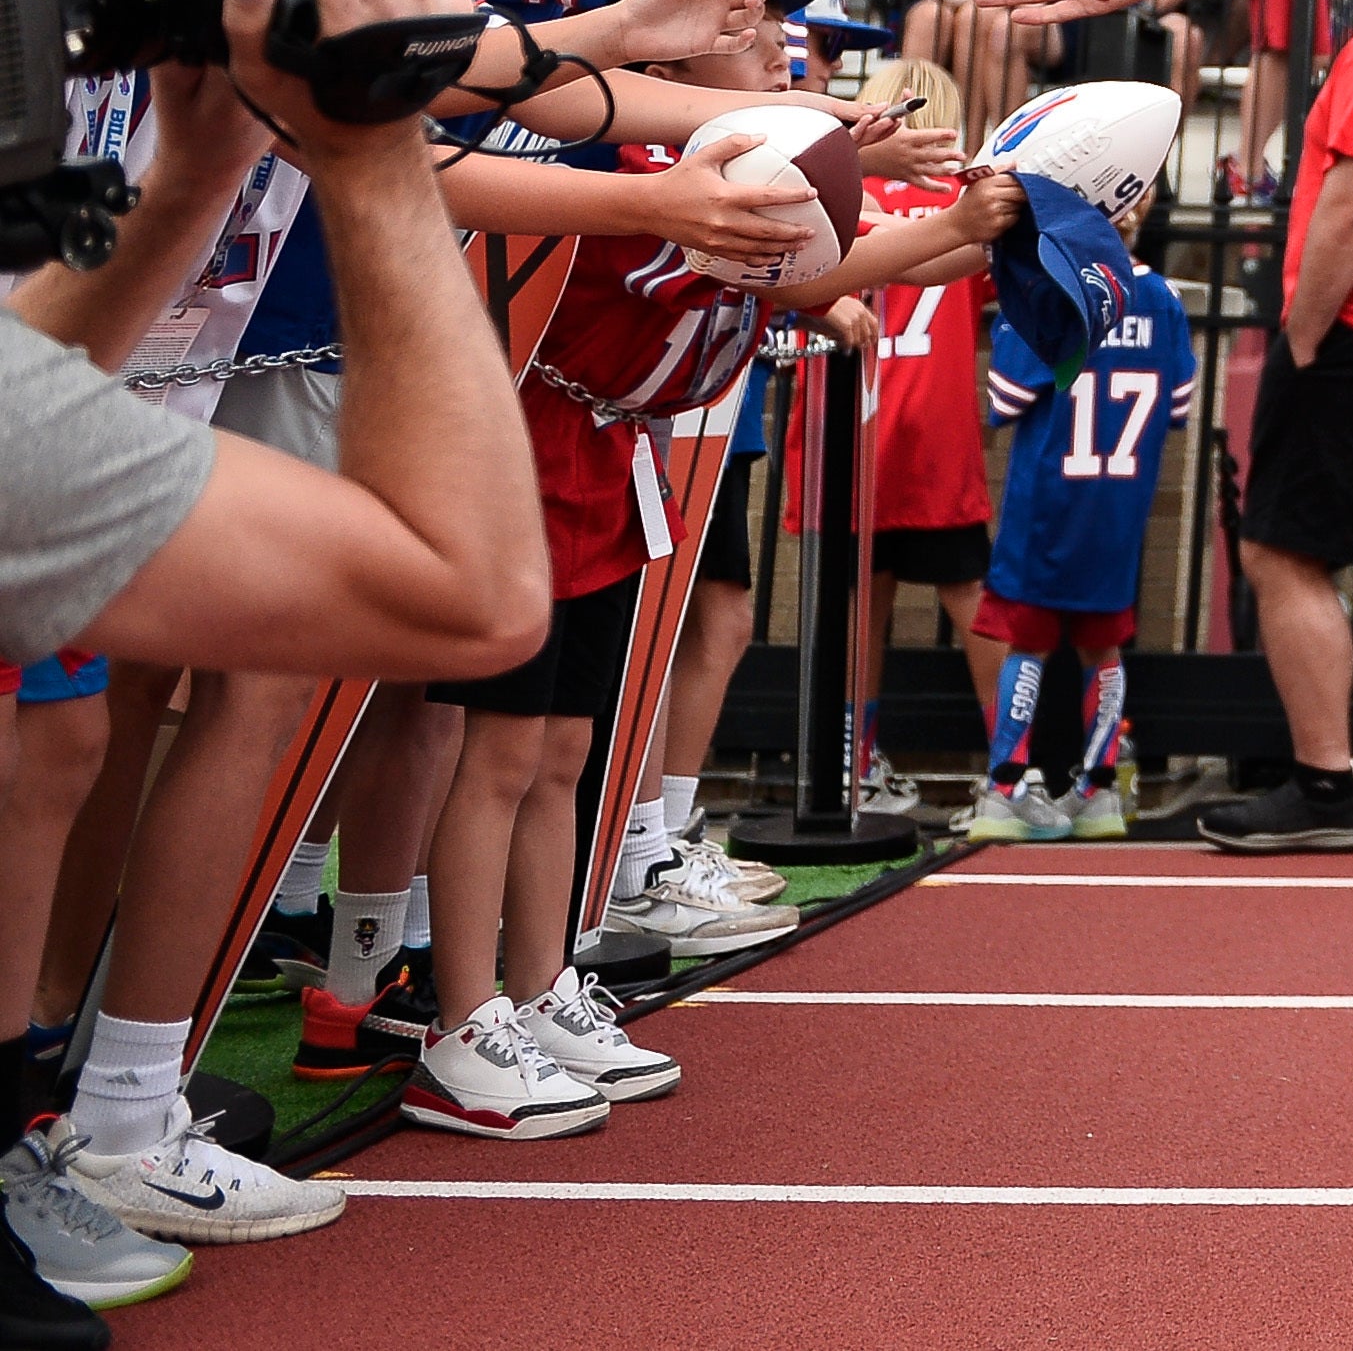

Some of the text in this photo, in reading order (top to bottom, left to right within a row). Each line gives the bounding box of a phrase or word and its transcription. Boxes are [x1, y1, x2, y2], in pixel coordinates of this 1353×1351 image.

[403, 33, 480, 58] FUJINON
[878, 285, 947, 360] 7
[1099, 315, 1154, 350] LEN
[1062, 370, 1159, 478] 17
[1009, 660, 1042, 724] DIGGS
